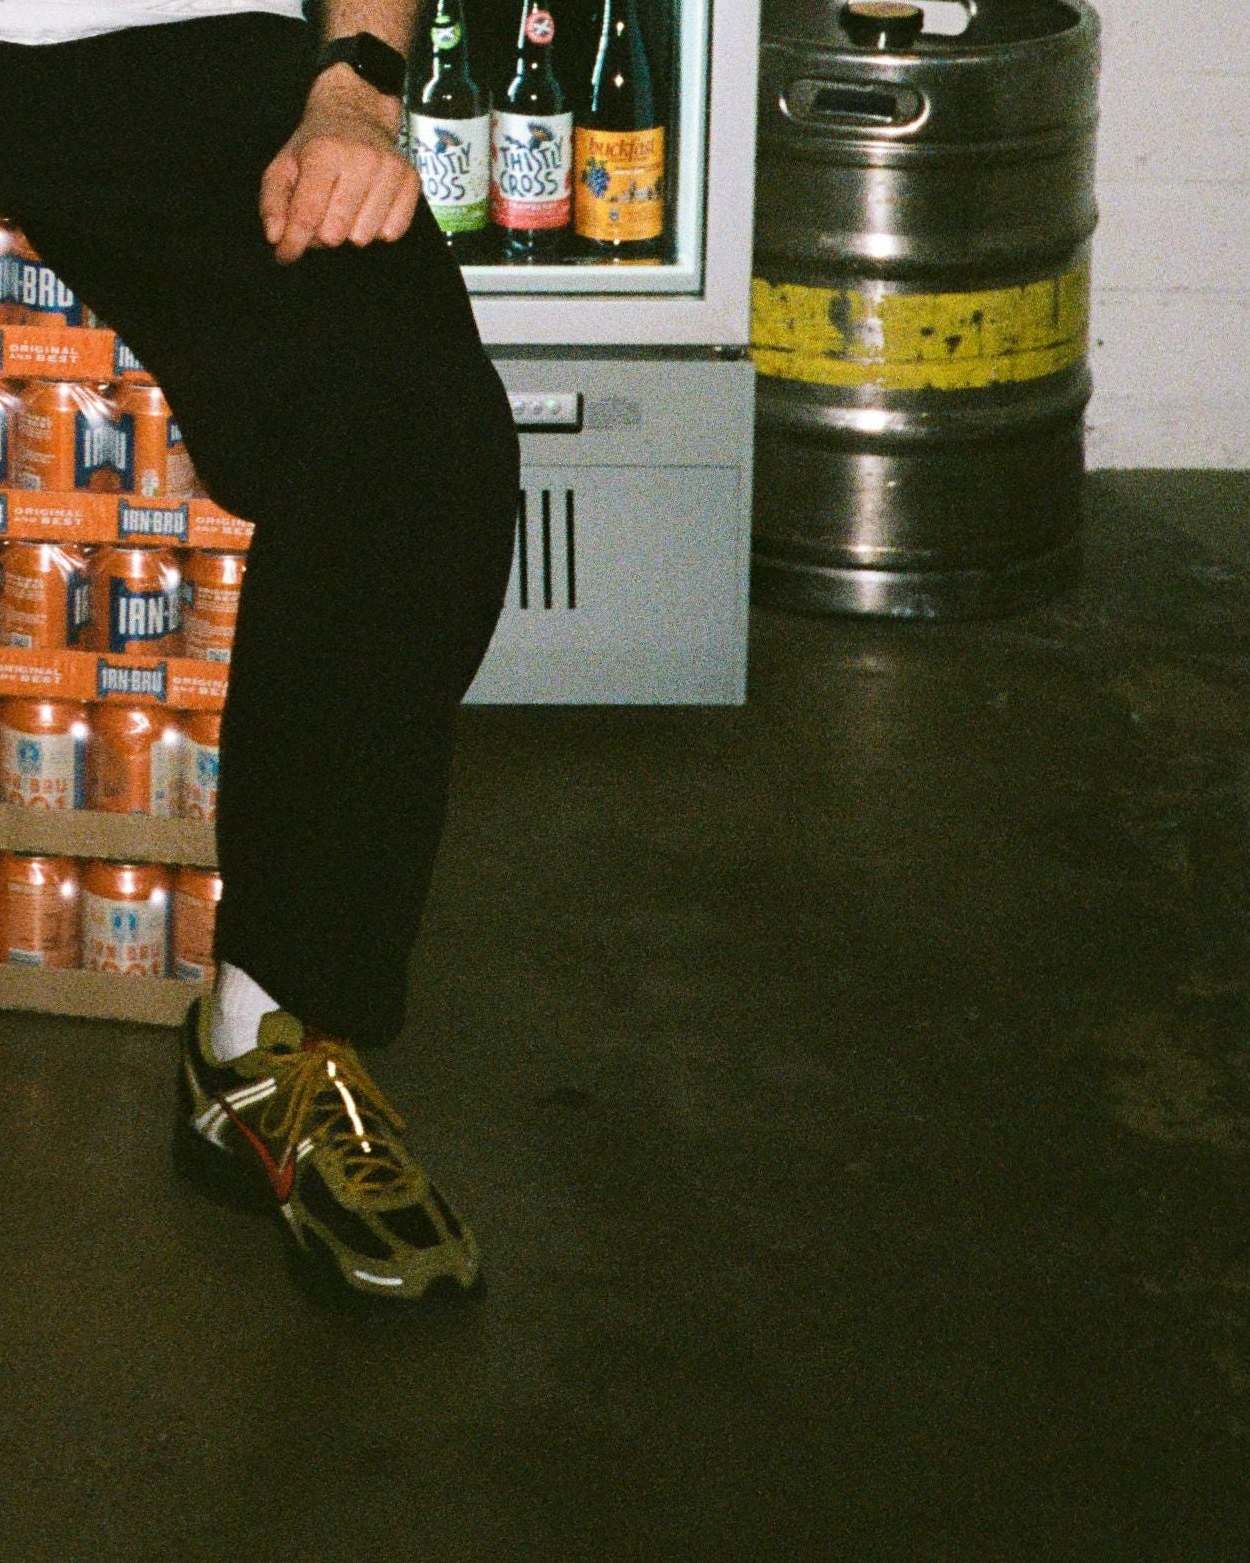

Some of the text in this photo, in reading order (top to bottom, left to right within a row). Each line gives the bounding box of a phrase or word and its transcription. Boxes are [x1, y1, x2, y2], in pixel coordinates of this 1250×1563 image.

[500, 137, 563, 173] THISTLY
[501, 165, 559, 198] CROSS
[8, 343, 79, 356] ORIGINAL
[35, 353, 80, 363] BEST
[13, 506, 83, 519] ORIGINAL
[39, 517, 83, 526] BEST
[122, 508, 185, 535] IRN-BRU
[19, 674, 62, 684] BEST
[101, 667, 163, 692] IRN-BRU
